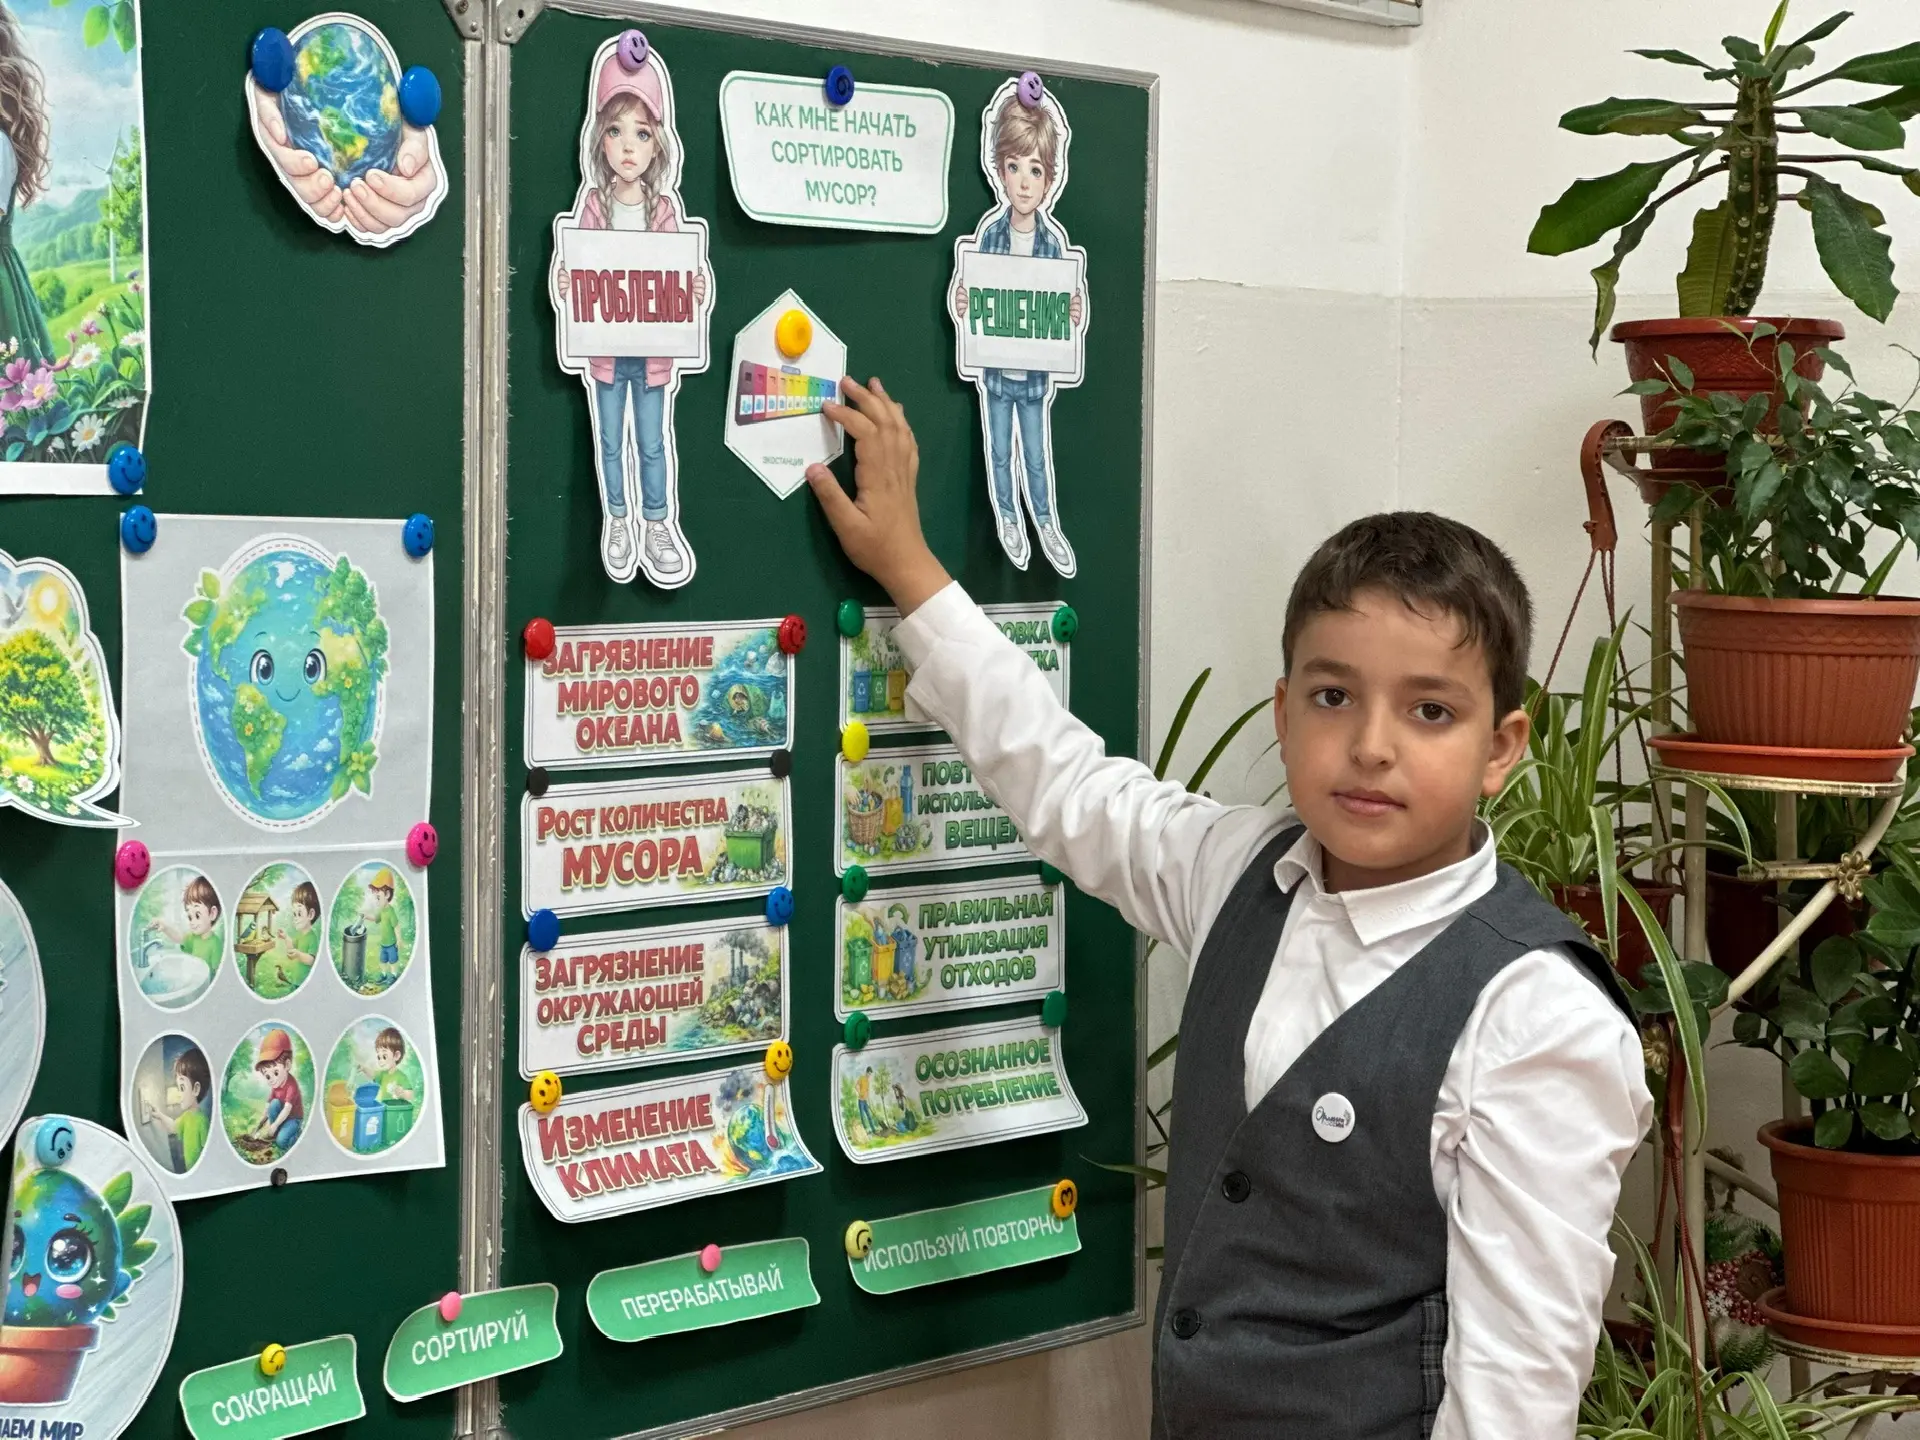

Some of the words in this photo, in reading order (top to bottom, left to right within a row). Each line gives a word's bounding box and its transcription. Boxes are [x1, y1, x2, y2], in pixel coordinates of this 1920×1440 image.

[755, 101, 794, 129] КАК
[799, 105, 839, 132] МНЕ
[844, 109, 917, 138] НАЧАТЬ
[771, 140, 903, 172] СОРТИРОВАТЬ
[805, 179, 877, 206] МУСОР?
[570, 268, 694, 323] ПРОБЛЕМЫ
[969, 287, 1071, 341] РЕШЕНИЯ
[762, 455, 804, 467] ЭКОСТАНЦИЯ
[542, 636, 714, 675] ЗАГРЯЗНЕНИЕ
[557, 675, 699, 713] МИРОВОГО
[575, 712, 683, 750] ОКЕАНА
[599, 797, 730, 835] КОЛИЧЕСТВА
[562, 835, 704, 888] МУСОРА
[918, 891, 1054, 929] ПРАВИЛЬНАЯ
[923, 924, 1048, 961] УТИЛИЗАЦИЯ
[535, 943, 705, 991] ЗАГРЯЗНЕНИЕ
[940, 955, 1037, 990] ОТХОДОВ
[537, 976, 704, 1025] ОКРУЖАЮЩЕЙ
[576, 1015, 667, 1055] СРЕДЫ
[915, 1037, 1052, 1082] ОСОЗНАННОЕ
[919, 1071, 1062, 1117] ПОТРЕБЛЕНИЕ
[537, 1093, 715, 1163] ИЗМЕНЕНИЕ
[555, 1139, 718, 1200] КЛИМАТА
[863, 1226, 971, 1273] ИСПОЛЬЗУЙ
[973, 1213, 1064, 1250] ПОВТОРНО
[620, 1262, 785, 1321] ПЕРЕРАБАТЫВАЙ
[411, 1309, 530, 1366] СОРТИРУЙ
[211, 1361, 337, 1427] СОКРАЩАЙ
[39, 1419, 84, 1440] МИР
